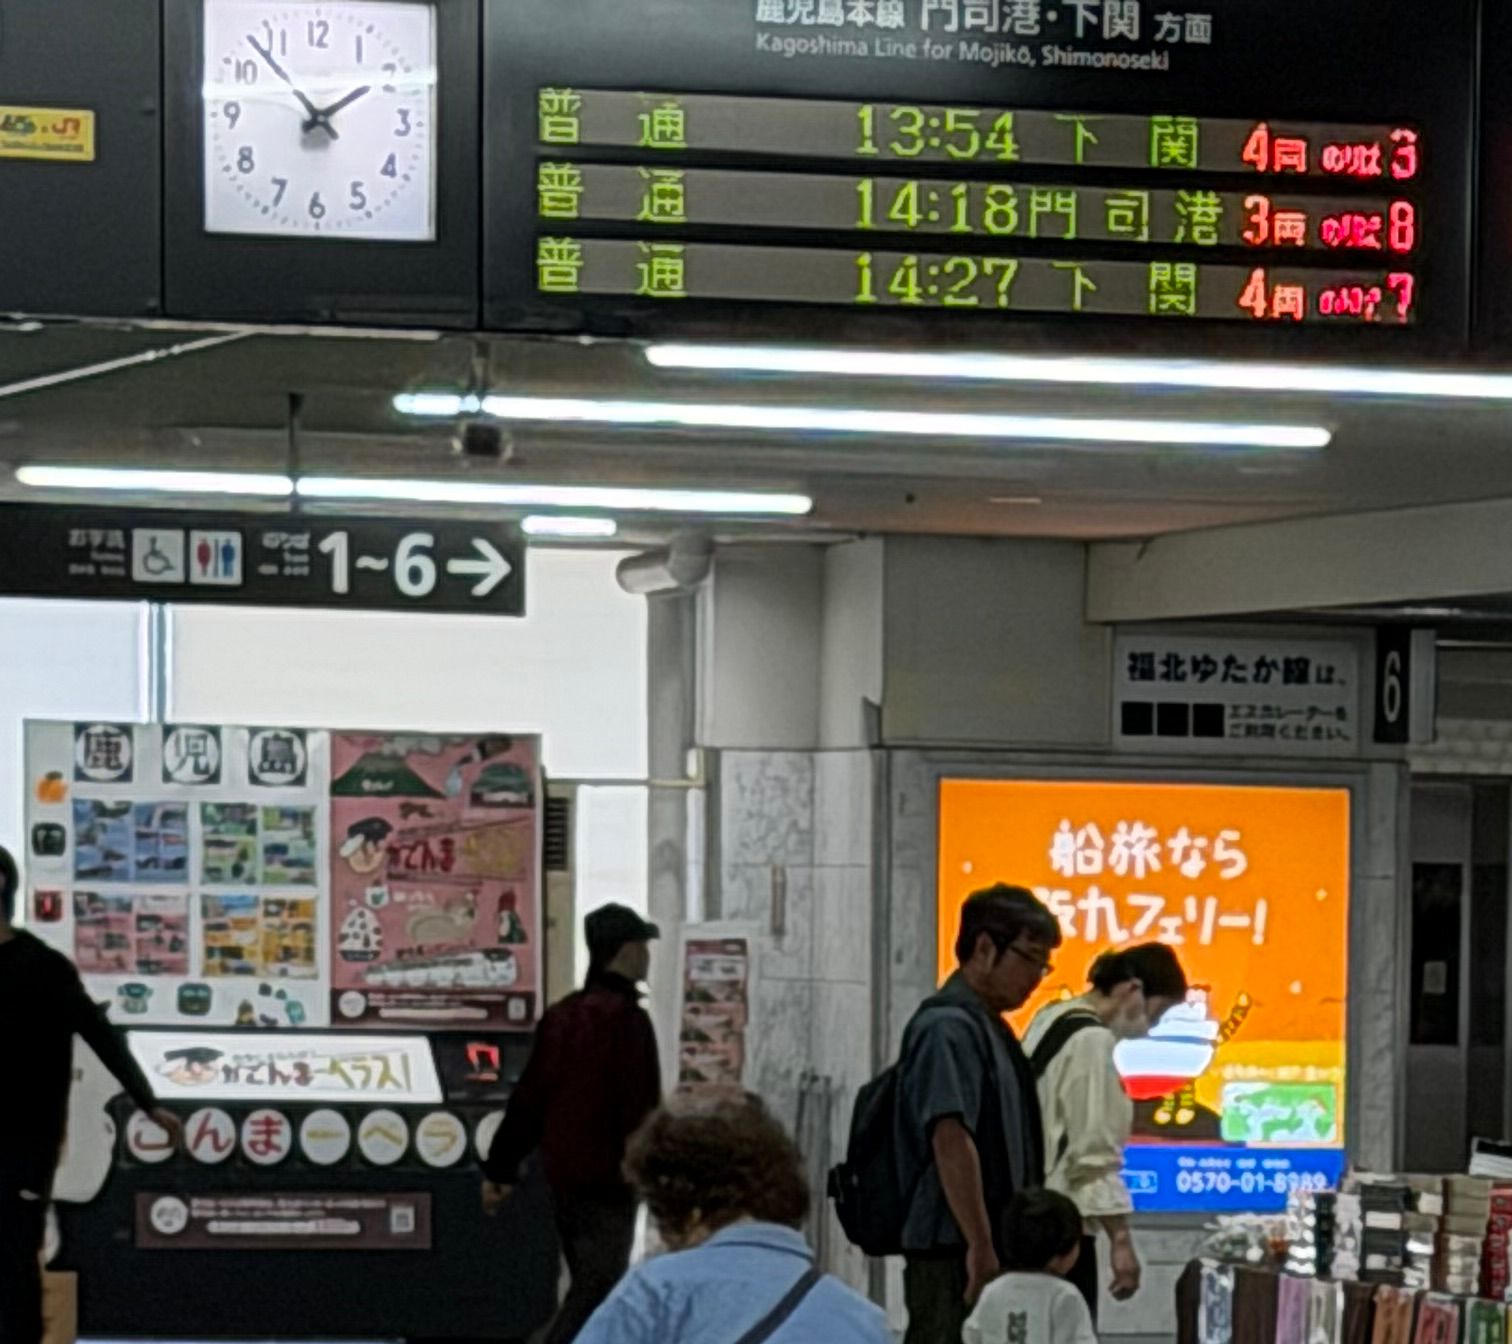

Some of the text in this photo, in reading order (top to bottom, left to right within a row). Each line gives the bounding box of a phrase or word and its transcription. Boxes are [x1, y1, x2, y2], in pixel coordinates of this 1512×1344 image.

[308, 20, 330, 49] 12
[921, 0, 1139, 41] 門司港・下関
[1154, 12, 1212, 44] 方面
[355, 35, 363, 64] 1
[756, 32, 868, 58] Kagoshima
[875, 36, 917, 58] Line
[924, 39, 951, 60] for
[1042, 46, 1169, 71] Shimonoseki
[235, 59, 258, 85] 10
[223, 101, 241, 130] 9
[394, 108, 411, 137] 3
[538, 87, 687, 149] 普通
[855, 104, 1019, 161] 13:54
[1053, 112, 1198, 169] 下関
[237, 146, 255, 175] 8
[380, 153, 397, 179] 4
[271, 177, 288, 208] 7
[308, 192, 326, 220] 6
[349, 181, 367, 210] 5
[538, 162, 687, 222] 普通
[855, 178, 1019, 237] 14:18
[1029, 187, 1223, 246] 門司港
[537, 237, 687, 297] 普通
[854, 252, 1019, 309] 14:27
[1052, 260, 1197, 315] 下関
[1383, 650, 1402, 724] 6
[1049, 818, 1249, 879] 船旅なら
